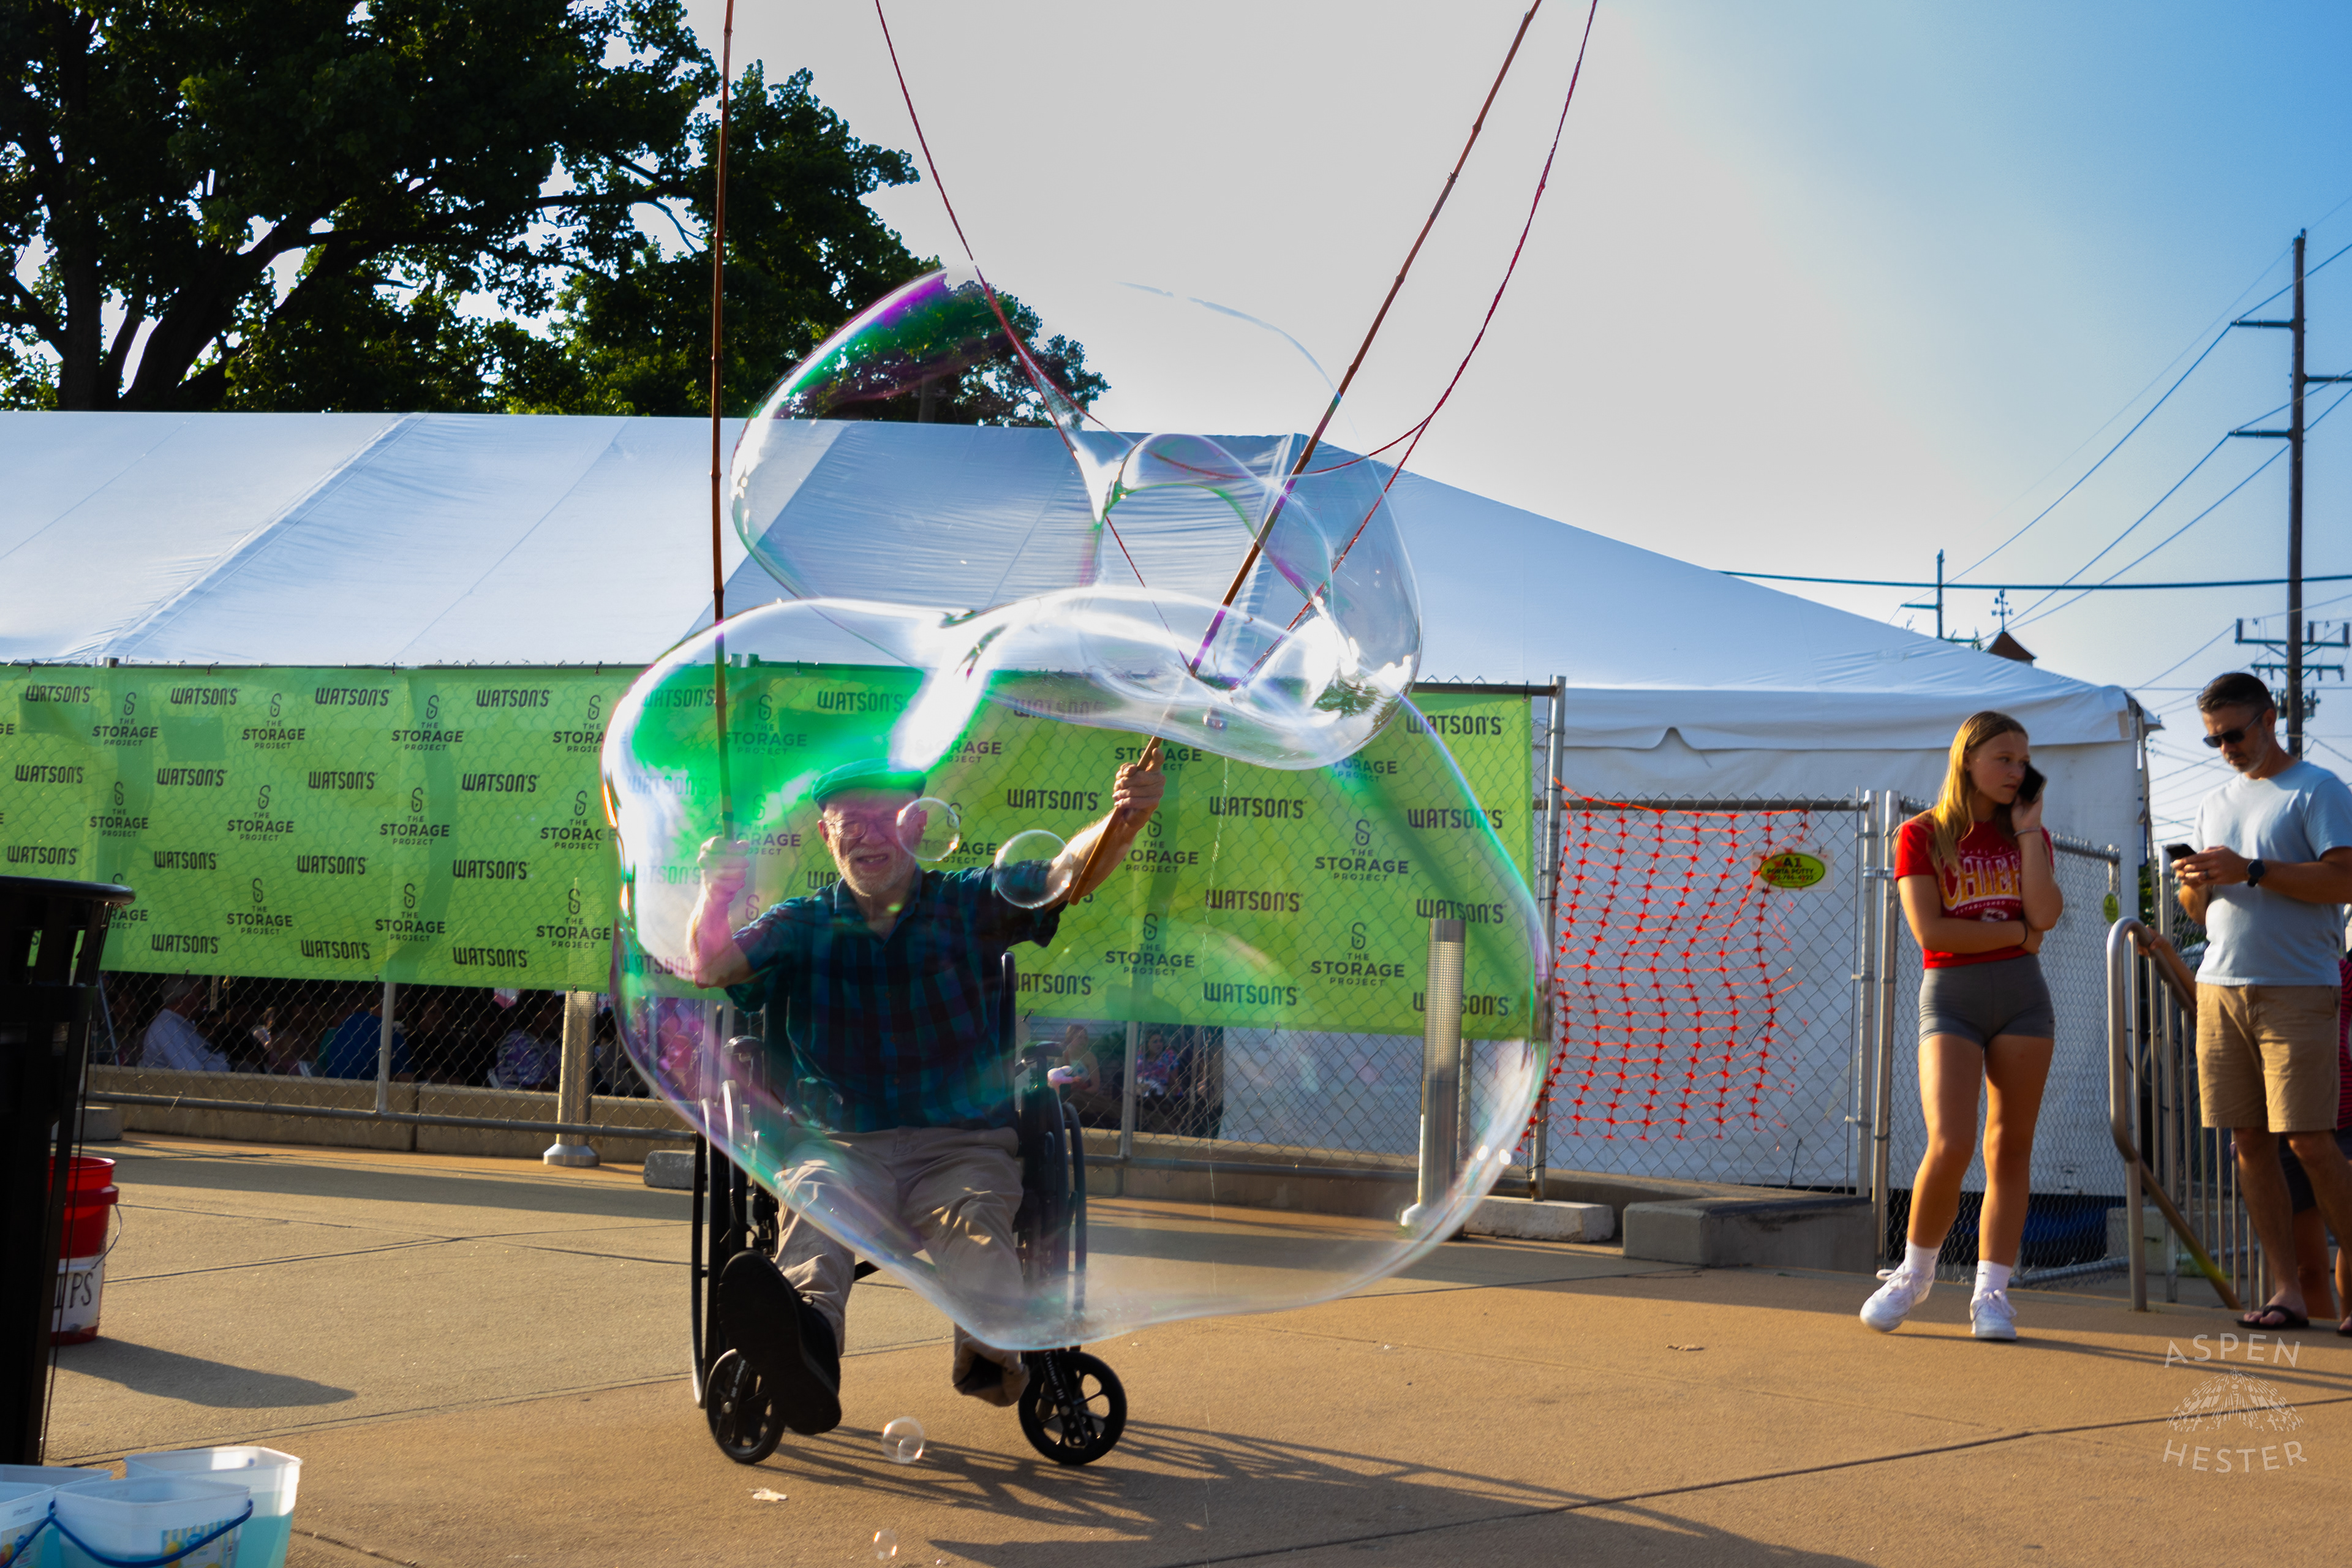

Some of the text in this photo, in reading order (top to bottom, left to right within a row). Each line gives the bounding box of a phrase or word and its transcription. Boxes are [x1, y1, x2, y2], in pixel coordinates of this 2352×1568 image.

[26, 685, 91, 703] WATSON'S
[171, 688, 238, 705] WATSON'S
[315, 688, 390, 706] WATSON'S
[476, 690, 549, 707] WATSON'S
[817, 692, 904, 712] WATSON'S
[92, 726, 158, 739] STORAGE
[1406, 715, 1501, 735] WATSON'S
[242, 729, 305, 741] STORAGE
[391, 730, 464, 743] STORAGE
[552, 731, 604, 744] STORA
[15, 765, 83, 783] WATSON'S
[157, 768, 224, 786] WATSON'S
[309, 772, 375, 790] WATSON'S
[462, 774, 537, 793] WATSON'S
[1008, 789, 1098, 811] WATSON'S
[1210, 797, 1303, 819] WATSON'S
[90, 816, 148, 829] STORAGE
[227, 820, 294, 833] STORAGE
[1408, 809, 1502, 829] WATSON'S
[380, 824, 450, 837] STORAGE
[7, 846, 77, 865] WATSON'S
[154, 851, 216, 870] WATSON'S
[1784, 857, 1802, 867] A1
[297, 856, 366, 875] WATSON'S
[453, 861, 527, 880] WATSON'S
[1126, 864, 1178, 873] PROJECT
[1315, 858, 1408, 874] STORAGE
[1207, 889, 1300, 912] WATSON'S
[227, 913, 293, 927] STORAGE
[1417, 899, 1504, 924] WATSON'S
[375, 919, 445, 934] STORAGE
[537, 925, 610, 940] STORAGE
[152, 935, 218, 954] WATSON'S
[301, 940, 370, 960] WATSON'S
[453, 948, 527, 968] WATSON'S
[1105, 951, 1195, 968] STORAGE
[1123, 967, 1176, 976] PROJECT
[1311, 961, 1404, 978] STORAGE
[1015, 973, 1091, 995] ATSON'S
[1330, 978, 1385, 987] PROJECT
[1204, 982, 1297, 1006] WATSON'S
[54, 1272, 93, 1308] IPS
